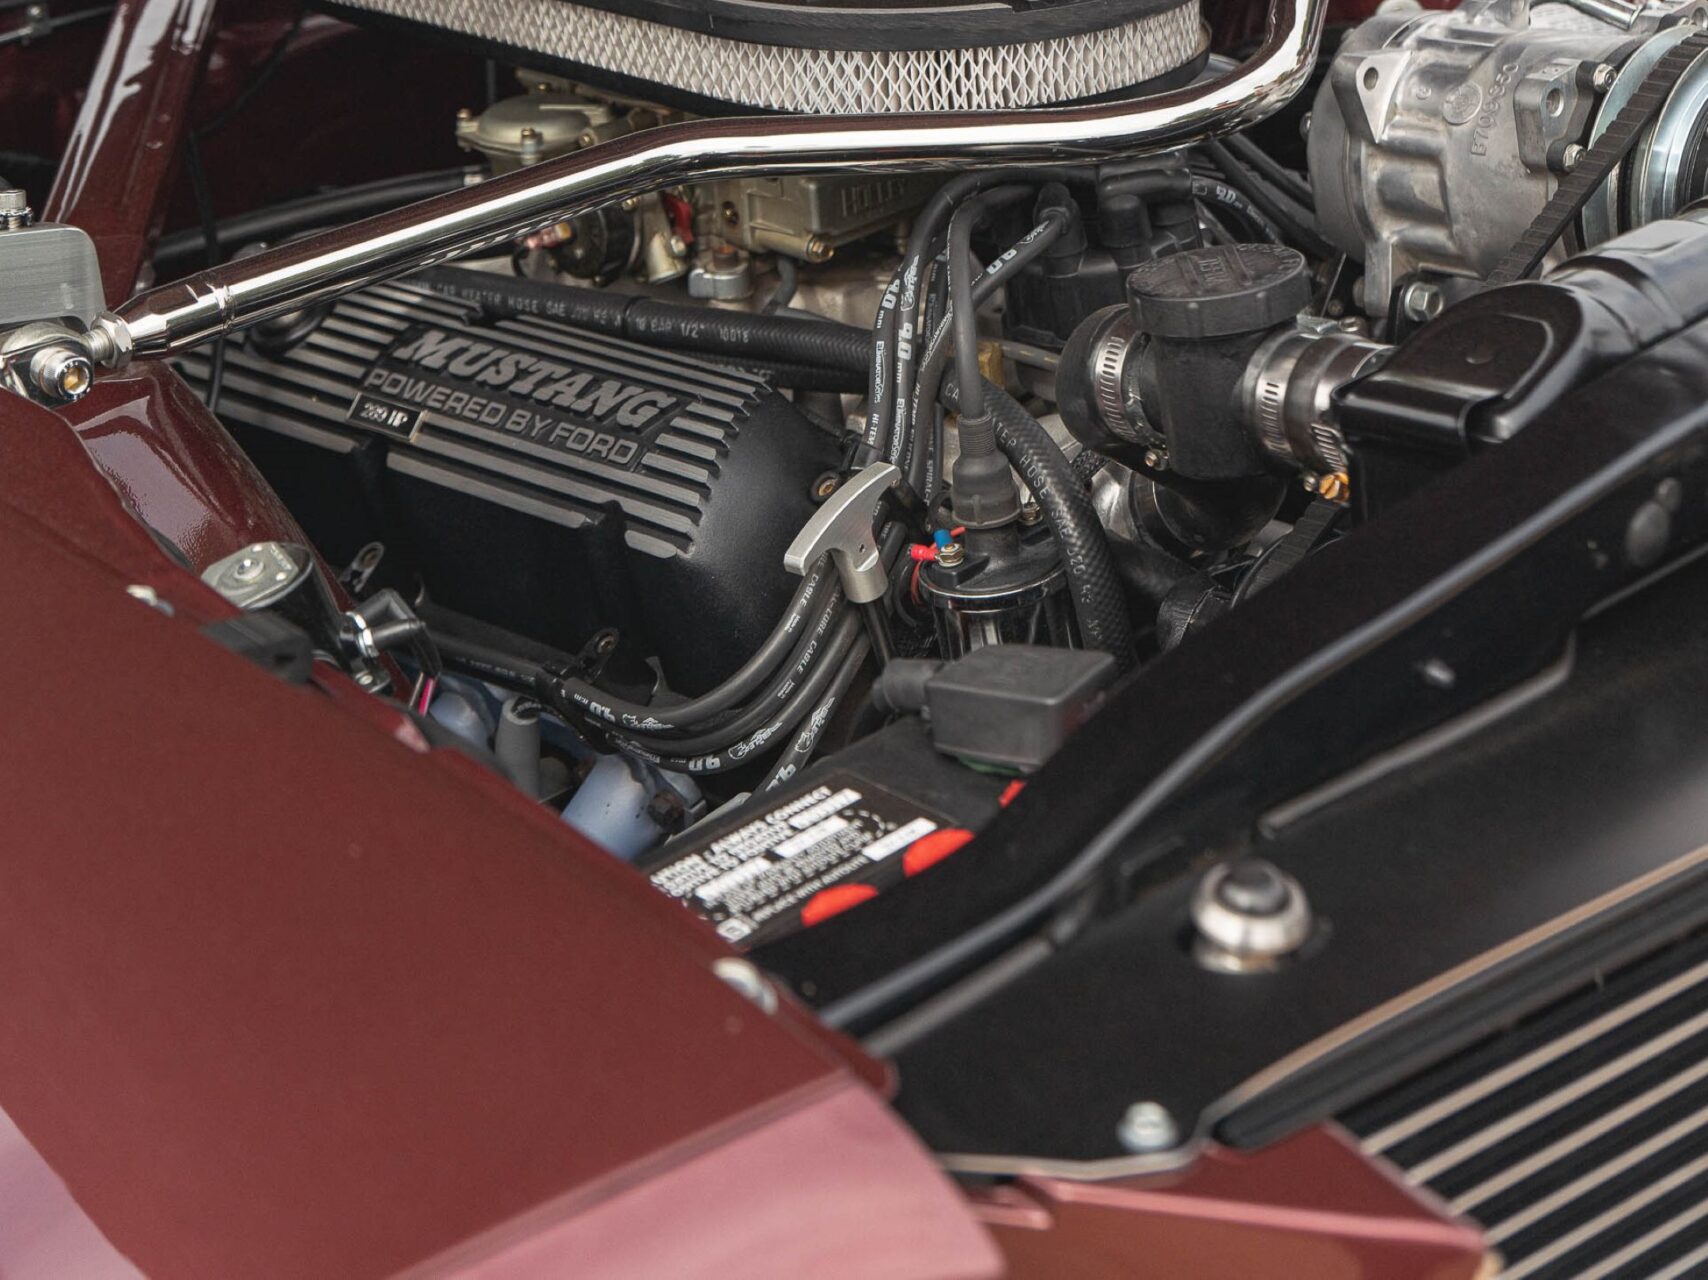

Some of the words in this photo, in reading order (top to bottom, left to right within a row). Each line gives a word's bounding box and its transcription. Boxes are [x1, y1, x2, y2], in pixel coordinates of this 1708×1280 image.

[508, 296, 539, 314] HOSE
[545, 300, 566, 317] SAE
[882, 278, 900, 310] 9.0
[876, 310, 885, 329] mm
[898, 322, 913, 360] 9.0
[393, 328, 677, 430] MUSTANG
[896, 362, 903, 383] mm
[363, 370, 506, 426] POWERED
[505, 409, 552, 438] BY
[549, 421, 639, 465] FORD
[867, 413, 880, 445] HI-TEM
[944, 382, 960, 401] CA
[1018, 453, 1051, 500] HOSE
[1050, 508, 1073, 539] SAE
[800, 573, 819, 608] CABLE
[798, 639, 817, 673] CABLE
[688, 755, 720, 771] 9.0
